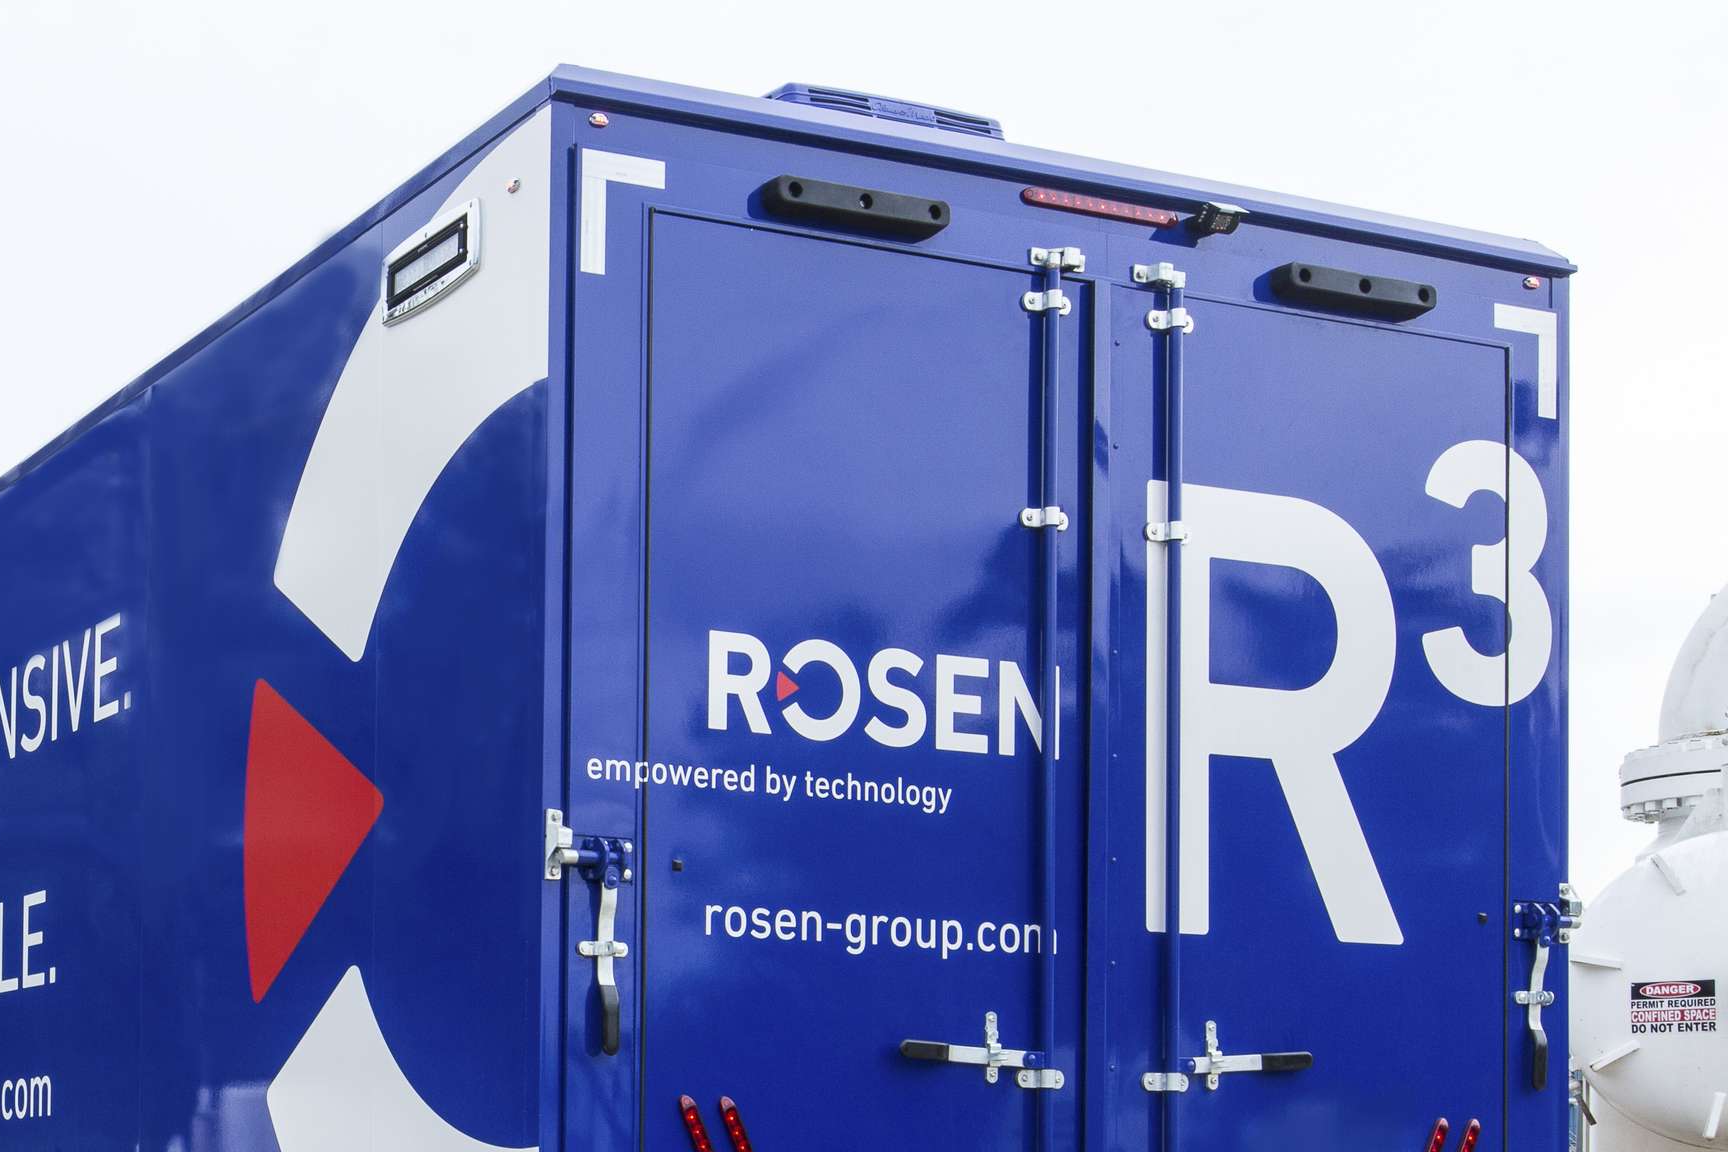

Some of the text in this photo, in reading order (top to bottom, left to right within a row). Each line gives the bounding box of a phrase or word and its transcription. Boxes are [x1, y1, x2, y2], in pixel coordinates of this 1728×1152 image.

[707, 630, 1060, 760] ROSEN
[586, 757, 953, 813] empowered by technology
[704, 904, 1058, 960] rosen-group.com
[1645, 984, 1694, 995] DANGER
[1631, 998, 1716, 1009] PERMIT REQUIRED
[1632, 1008, 1716, 1023] CONFINED SPACE
[1632, 1021, 1717, 1034] DO NOT ENTER
